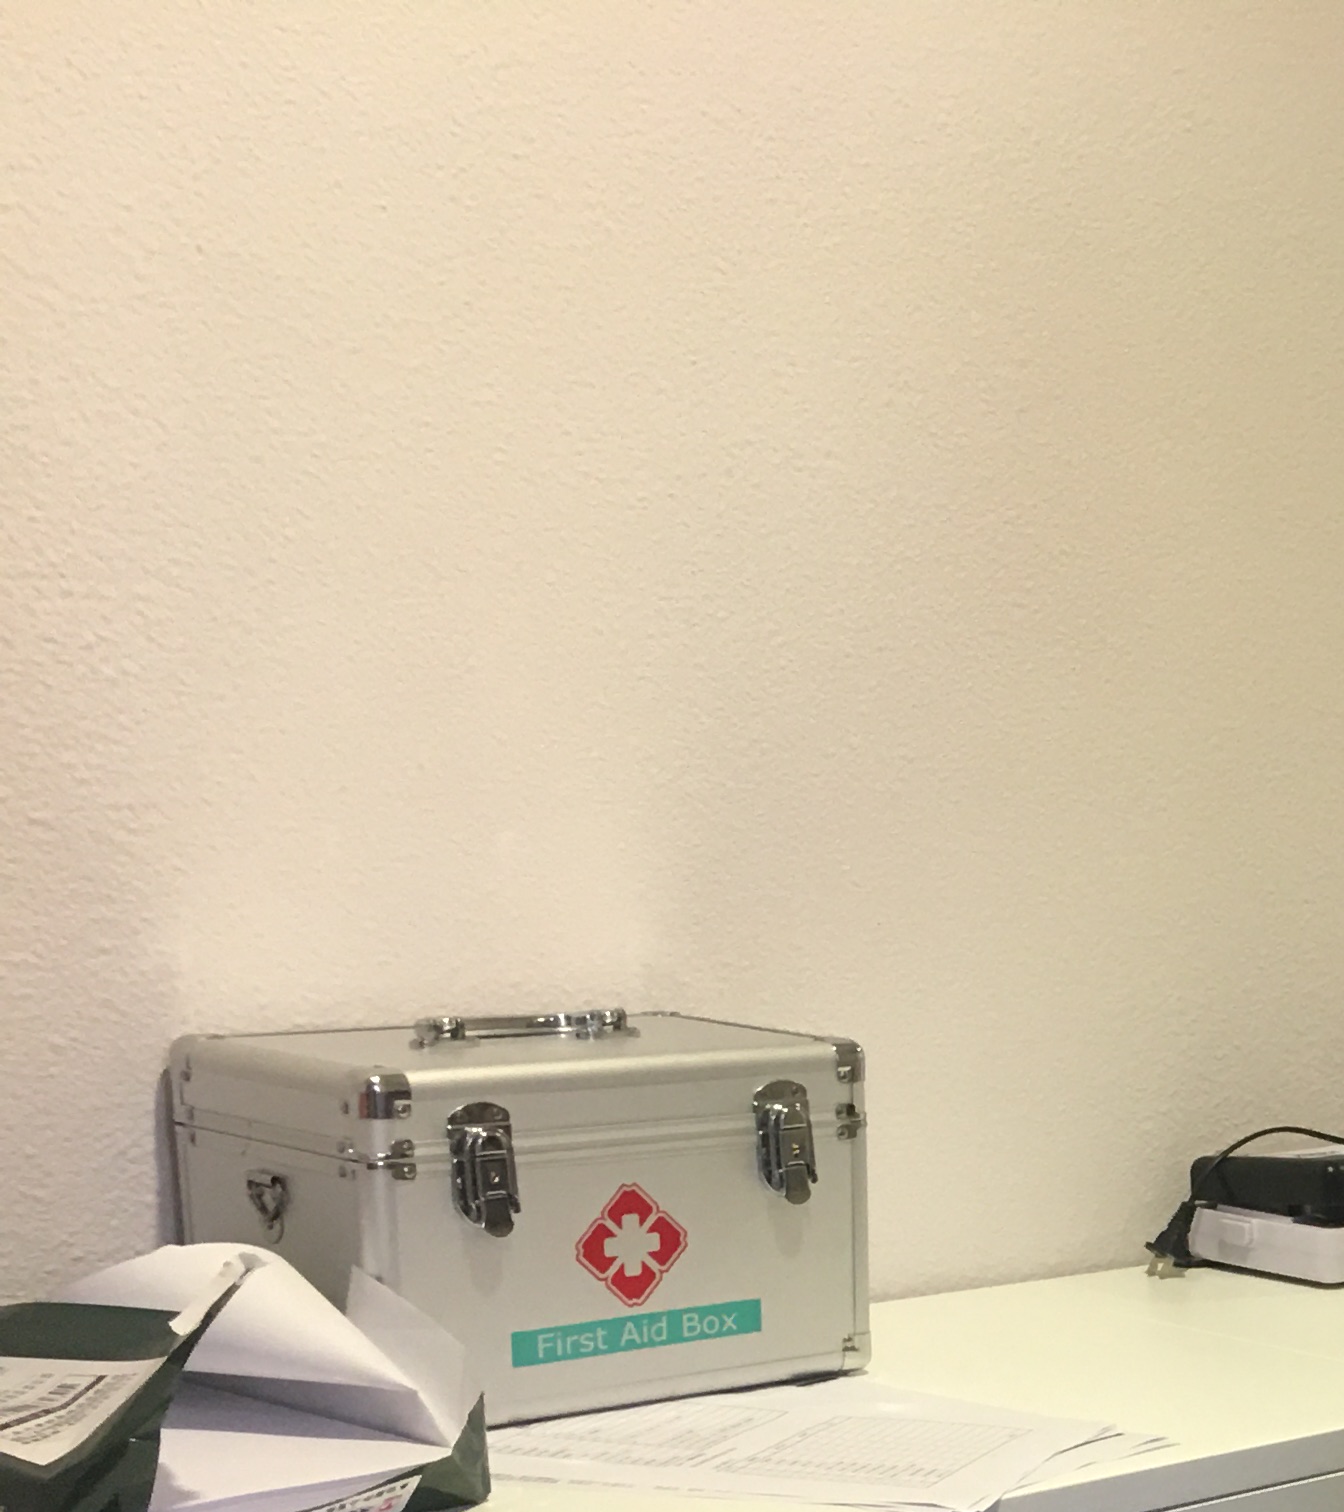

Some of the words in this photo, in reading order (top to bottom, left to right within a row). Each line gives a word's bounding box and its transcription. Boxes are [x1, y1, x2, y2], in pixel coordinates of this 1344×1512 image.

[537, 1327, 609, 1359] First
[620, 1314, 668, 1347] Aid
[682, 1312, 738, 1338] Box
